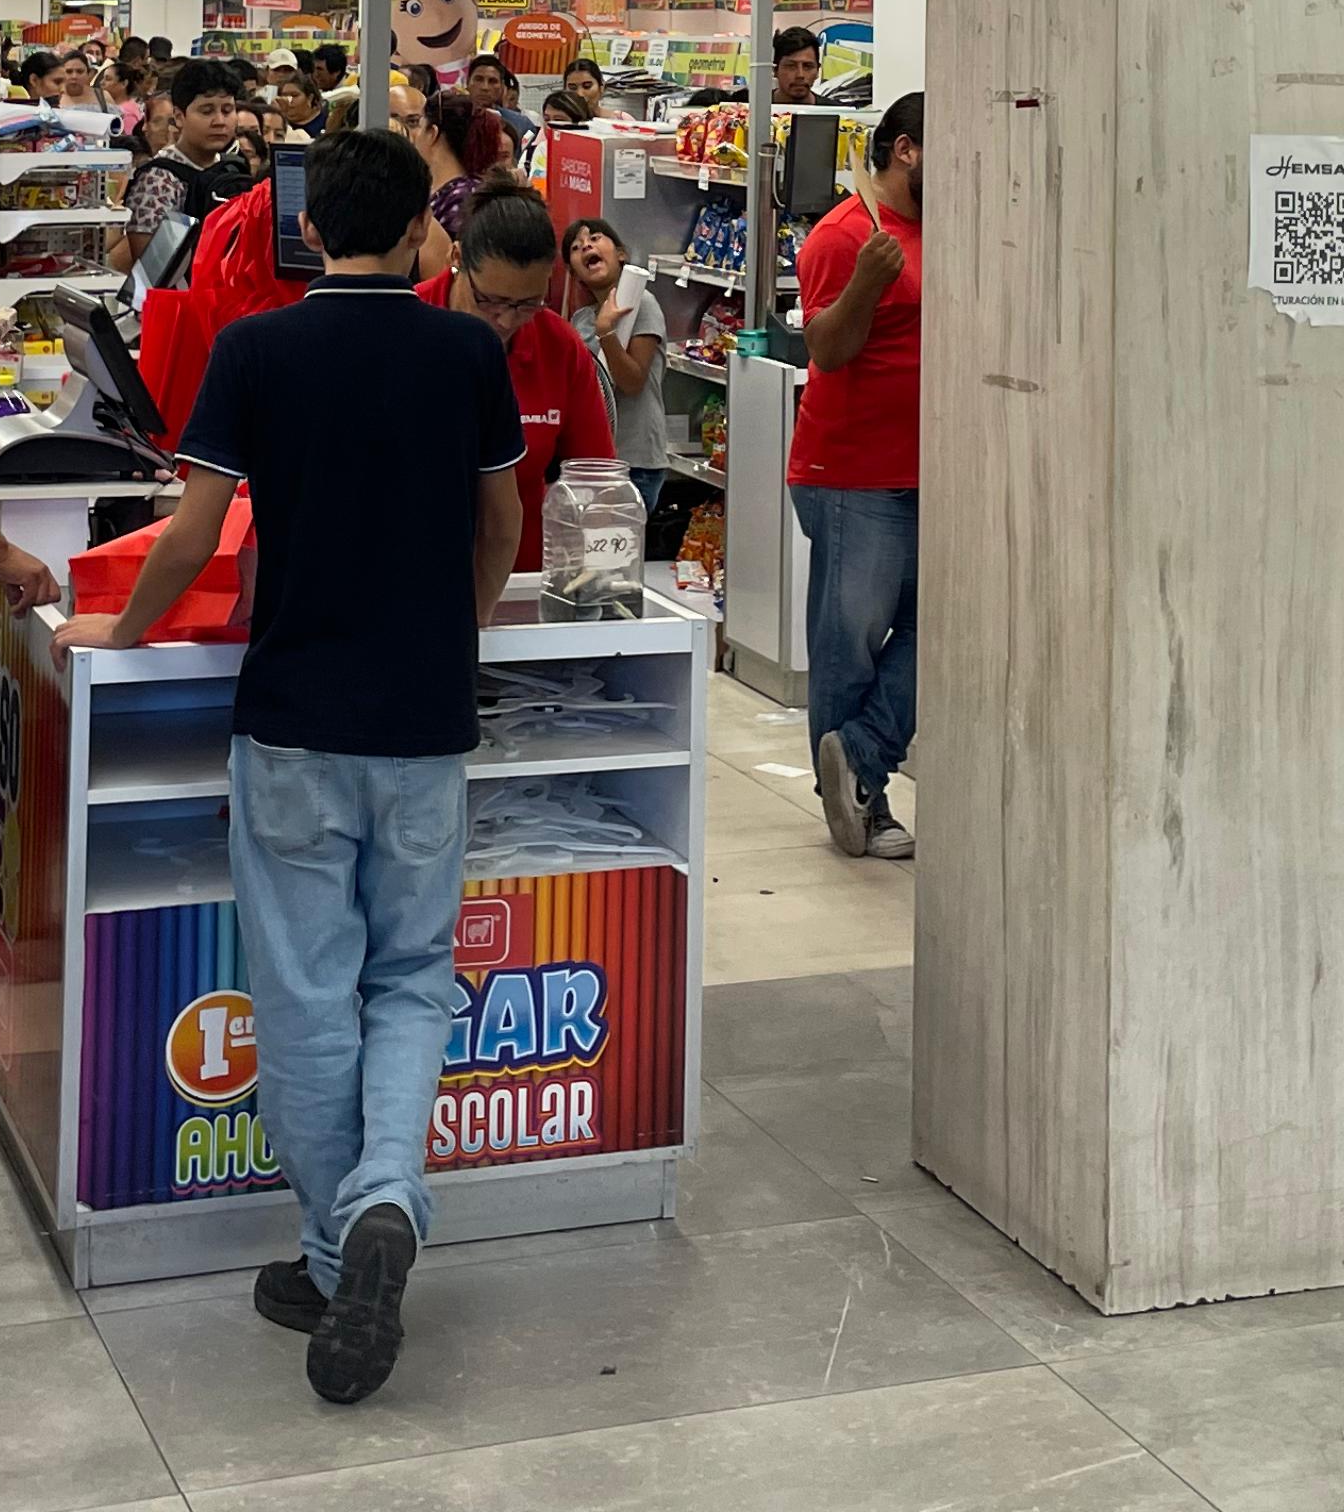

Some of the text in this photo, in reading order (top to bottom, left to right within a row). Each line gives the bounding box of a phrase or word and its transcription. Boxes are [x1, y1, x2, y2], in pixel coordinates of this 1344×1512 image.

[517, 22, 561, 31] JUEGOS DE
[560, 157, 592, 178] SABOREA
[560, 174, 592, 195] LA MAGIA
[1327, 297, 1339, 306] EN
